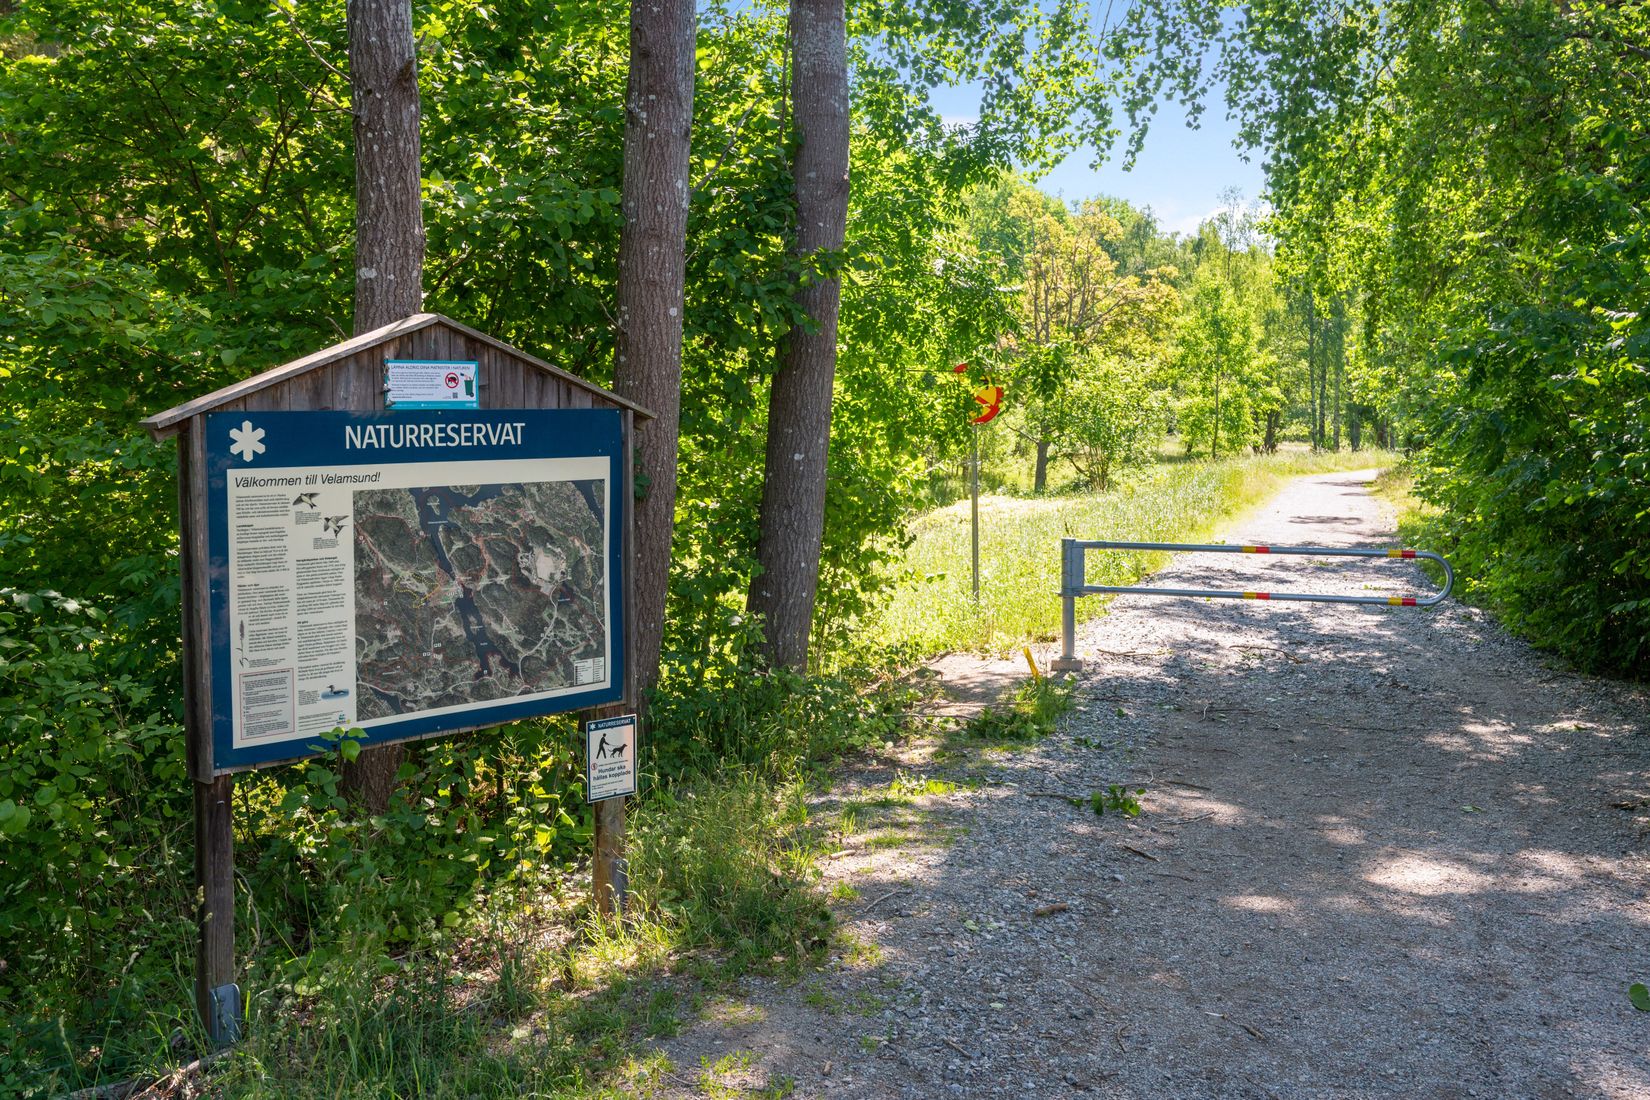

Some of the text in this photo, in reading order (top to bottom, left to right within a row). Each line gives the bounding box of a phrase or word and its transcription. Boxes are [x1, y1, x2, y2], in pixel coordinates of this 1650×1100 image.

[345, 422, 526, 450] NATURRESERVAT
[235, 472, 381, 488] Välkommen till Velamsund!
[597, 718, 631, 728] NATURRESERVAT
[609, 770, 631, 778] kopplade
